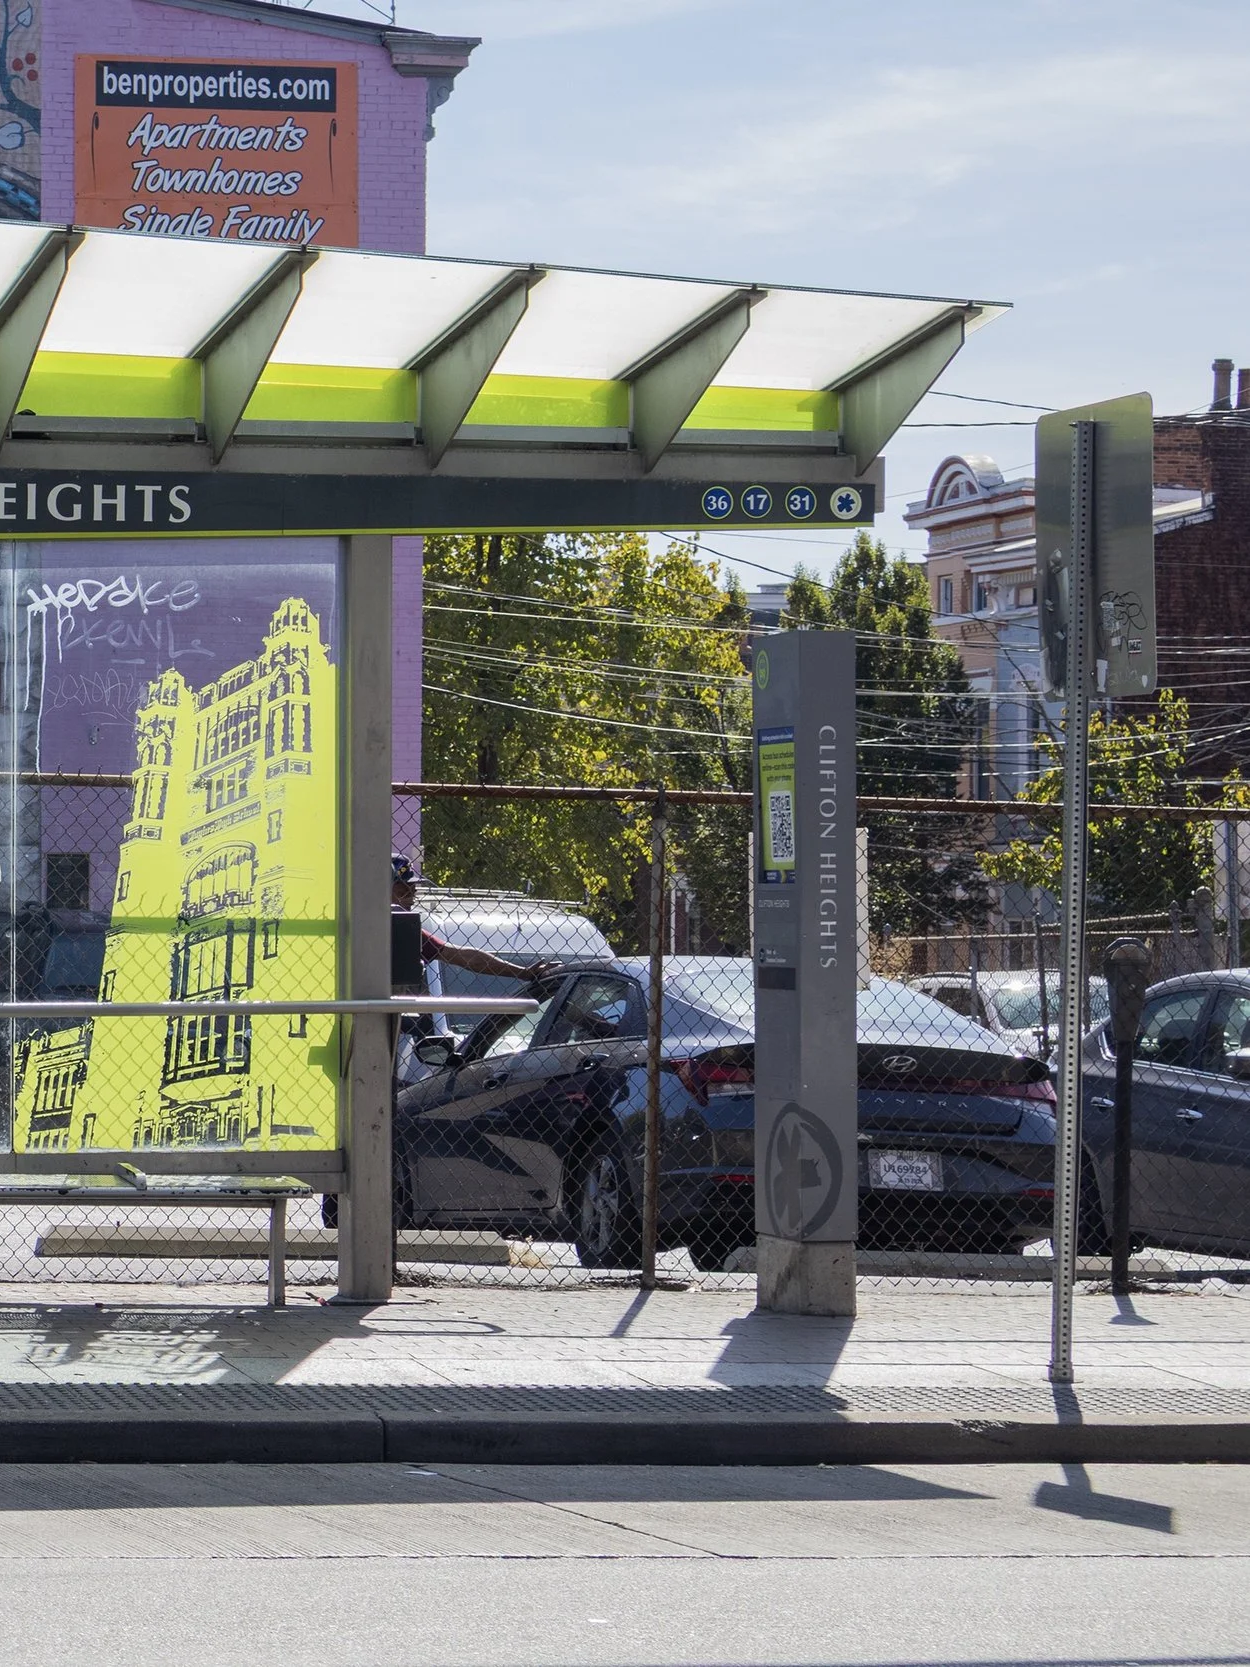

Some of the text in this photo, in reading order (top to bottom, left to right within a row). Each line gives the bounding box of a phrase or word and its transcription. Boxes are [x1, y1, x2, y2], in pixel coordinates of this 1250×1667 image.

[103, 66, 330, 103] benproperties.com
[127, 113, 308, 156] Apartments
[131, 157, 302, 197] Townhomes
[220, 204, 324, 245] Family
[707, 495, 728, 511] 36
[746, 494, 768, 510] 17
[789, 494, 811, 511] 31
[819, 725, 837, 968] CLIFTON HEIGHTS
